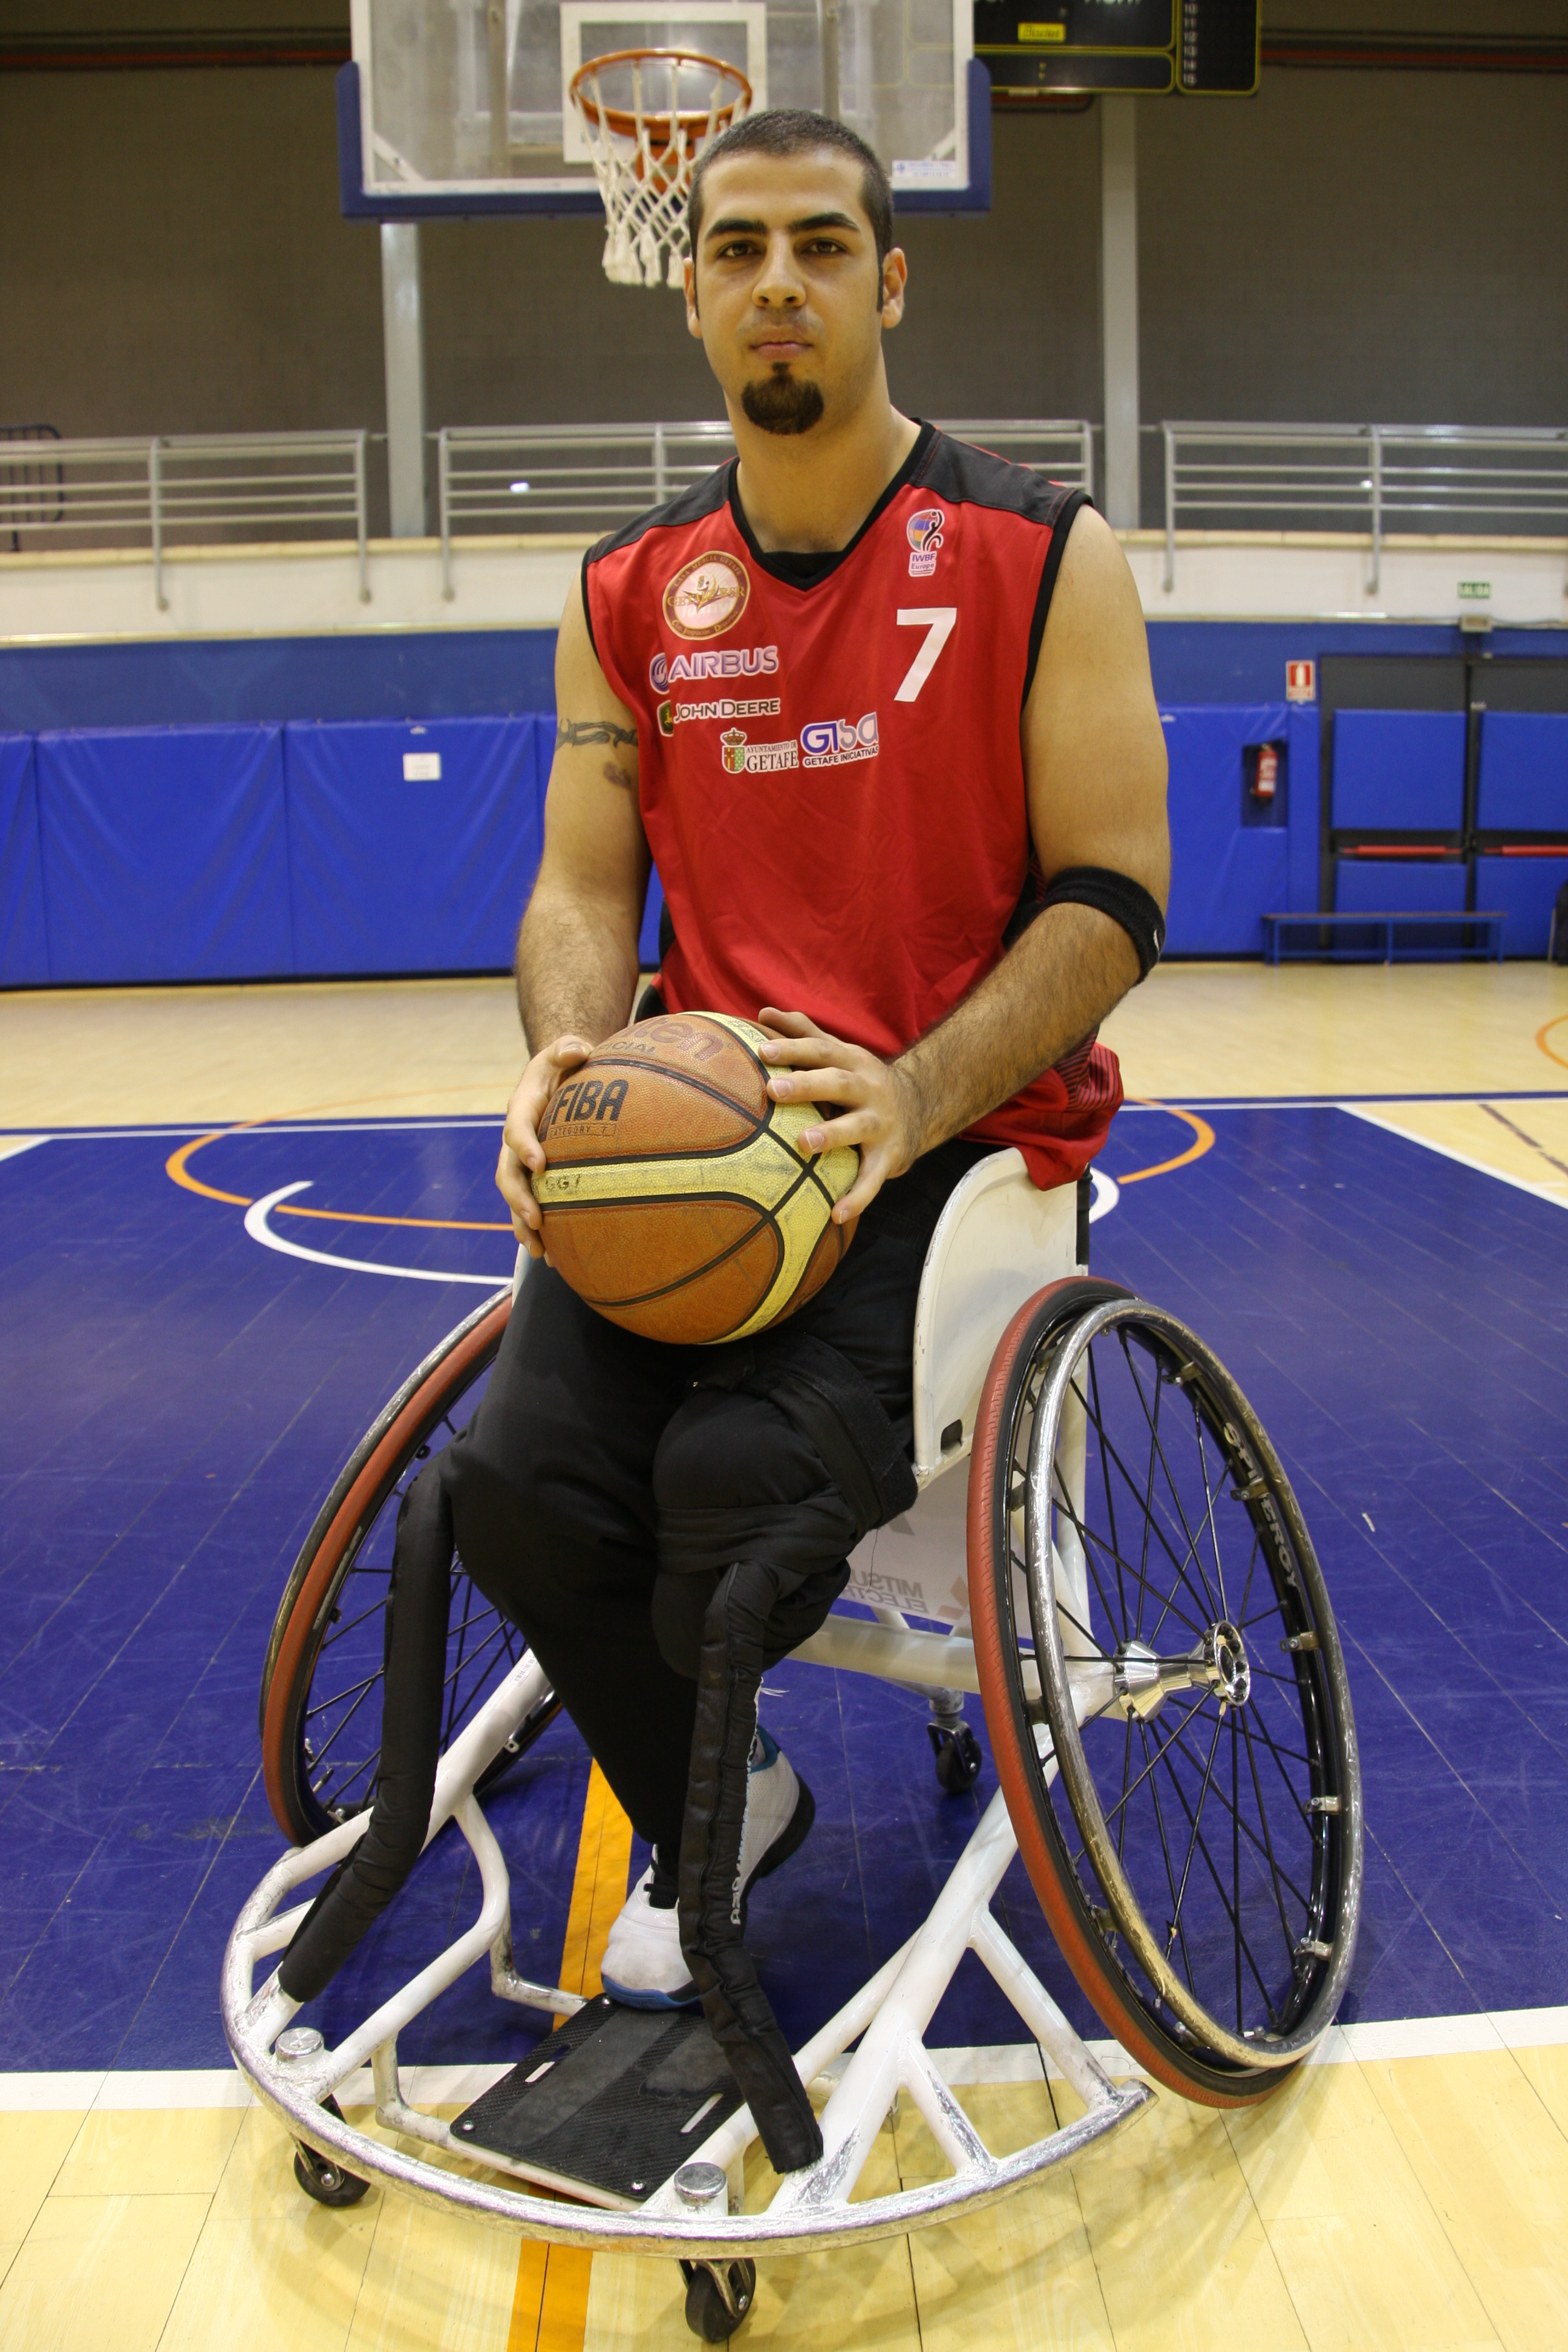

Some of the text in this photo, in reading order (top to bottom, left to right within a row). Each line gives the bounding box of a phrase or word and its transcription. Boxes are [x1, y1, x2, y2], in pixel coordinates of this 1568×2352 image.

[912, 553, 935, 561] IWBF
[669, 647, 778, 681] AIRBUS
[893, 607, 957, 702] 7
[675, 700, 779, 721] JOHN DEERE
[746, 742, 788, 753] AYUNTAMIENTO
[805, 746, 879, 766] GETAFE INICIATIVAS
[746, 751, 798, 771] GETAFE
[551, 1079, 629, 1125] FIBA
[547, 1125, 591, 1138] CATEGORY
